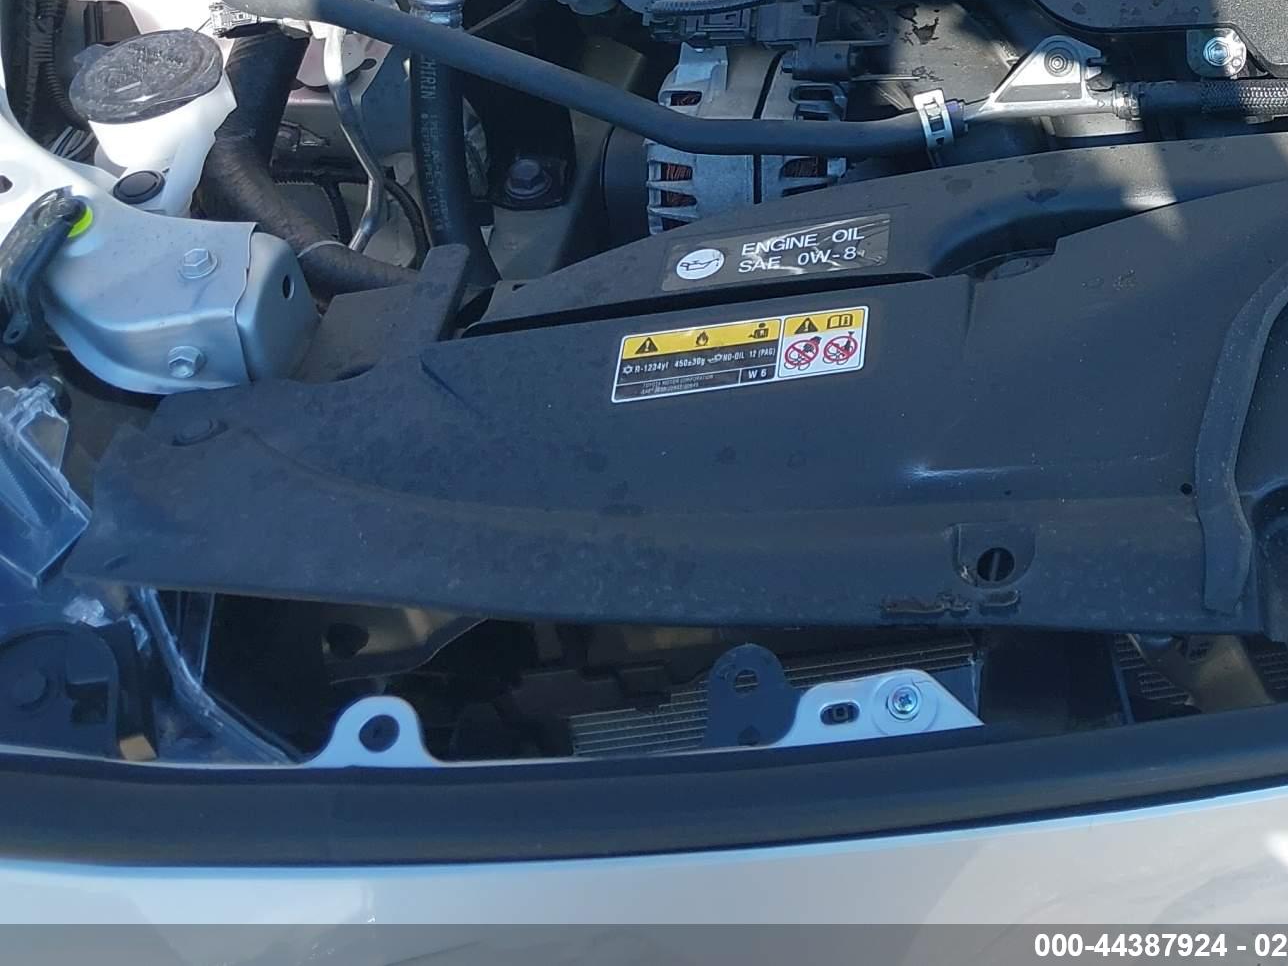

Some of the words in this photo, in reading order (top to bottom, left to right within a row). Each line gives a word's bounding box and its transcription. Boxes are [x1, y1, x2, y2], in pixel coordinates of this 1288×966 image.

[741, 233, 818, 256] ENGINE
[831, 227, 865, 243] OIL
[738, 255, 782, 273] SAE
[797, 246, 857, 266] 0W-8
[748, 369, 758, 379] W
